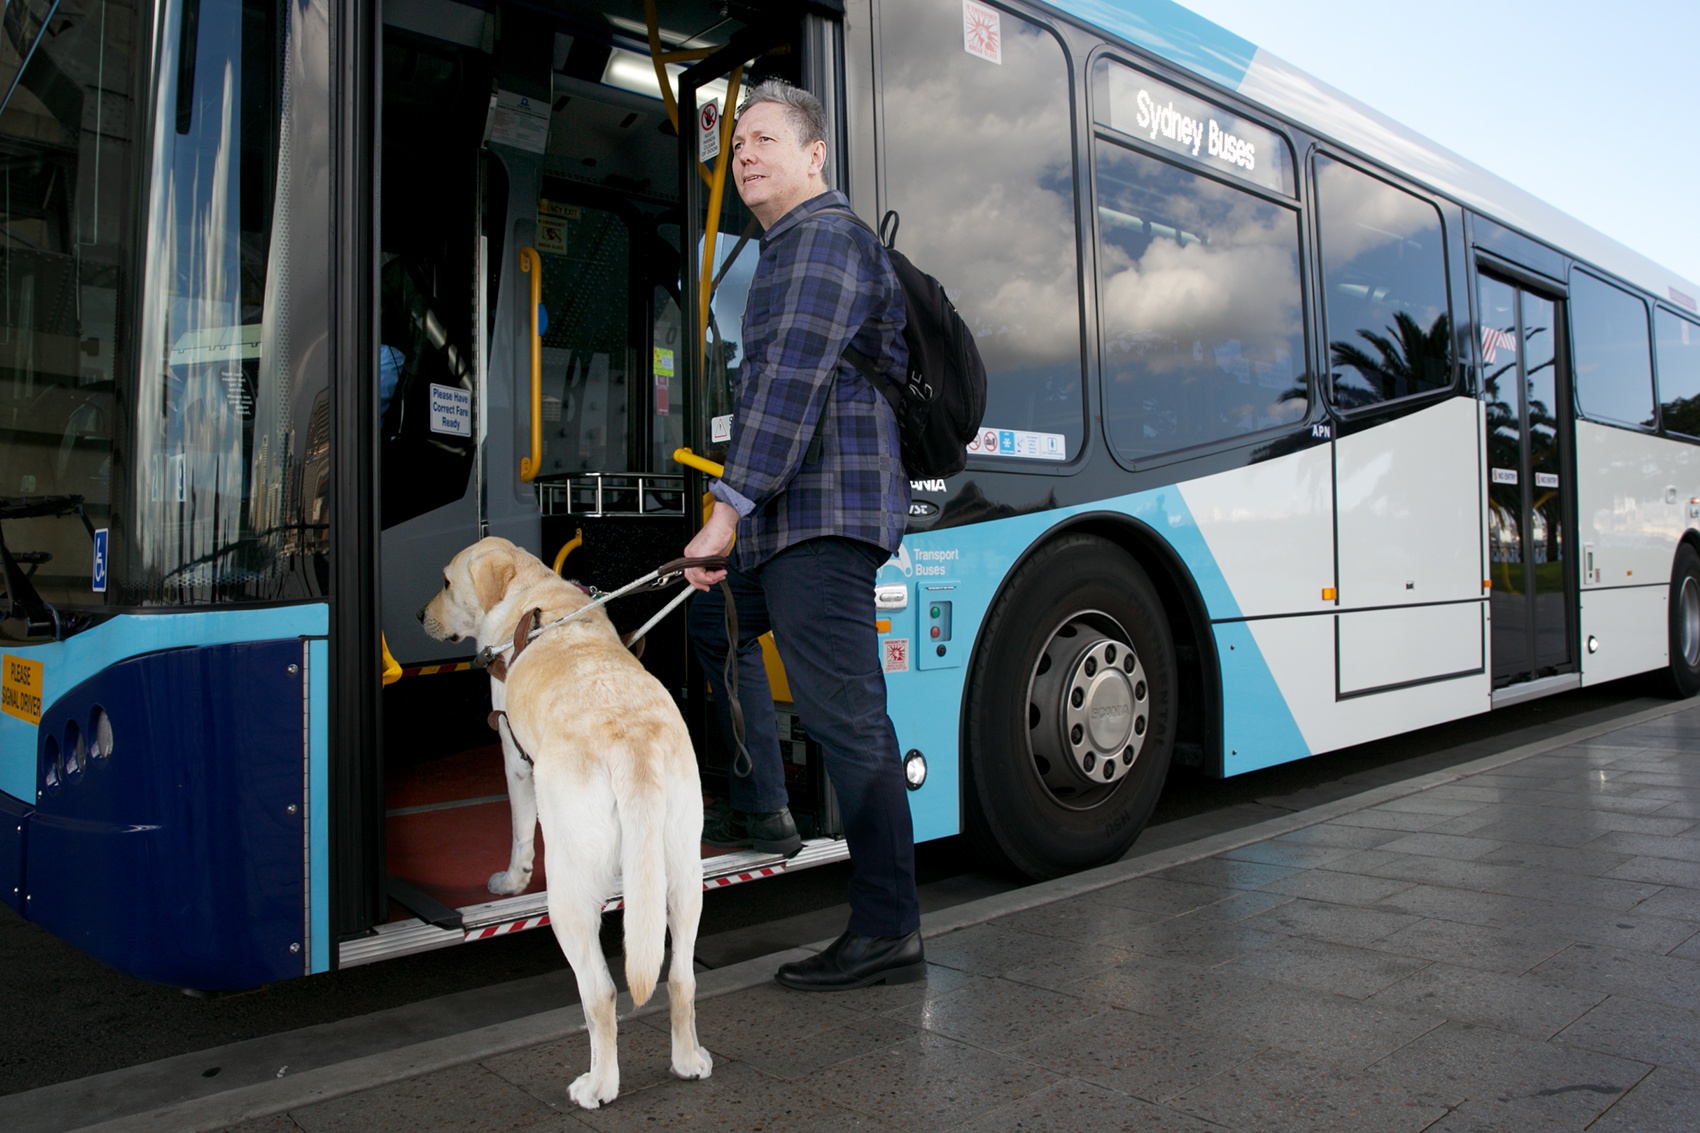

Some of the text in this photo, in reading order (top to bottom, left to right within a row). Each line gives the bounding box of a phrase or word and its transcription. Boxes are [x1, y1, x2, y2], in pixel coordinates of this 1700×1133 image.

[1136, 89, 1255, 170] Sydney Buses
[433, 388, 468, 404] Please Have
[432, 401, 469, 417] Correct Fare
[442, 416, 460, 431] Ready
[1312, 424, 1331, 438] APN
[913, 548, 959, 563] Transport
[915, 564, 946, 576] Buses
[11, 662, 31, 686] PLEASE
[2, 686, 42, 717] SIGNAL DRIVER
[1091, 704, 1130, 719] SCANIA
